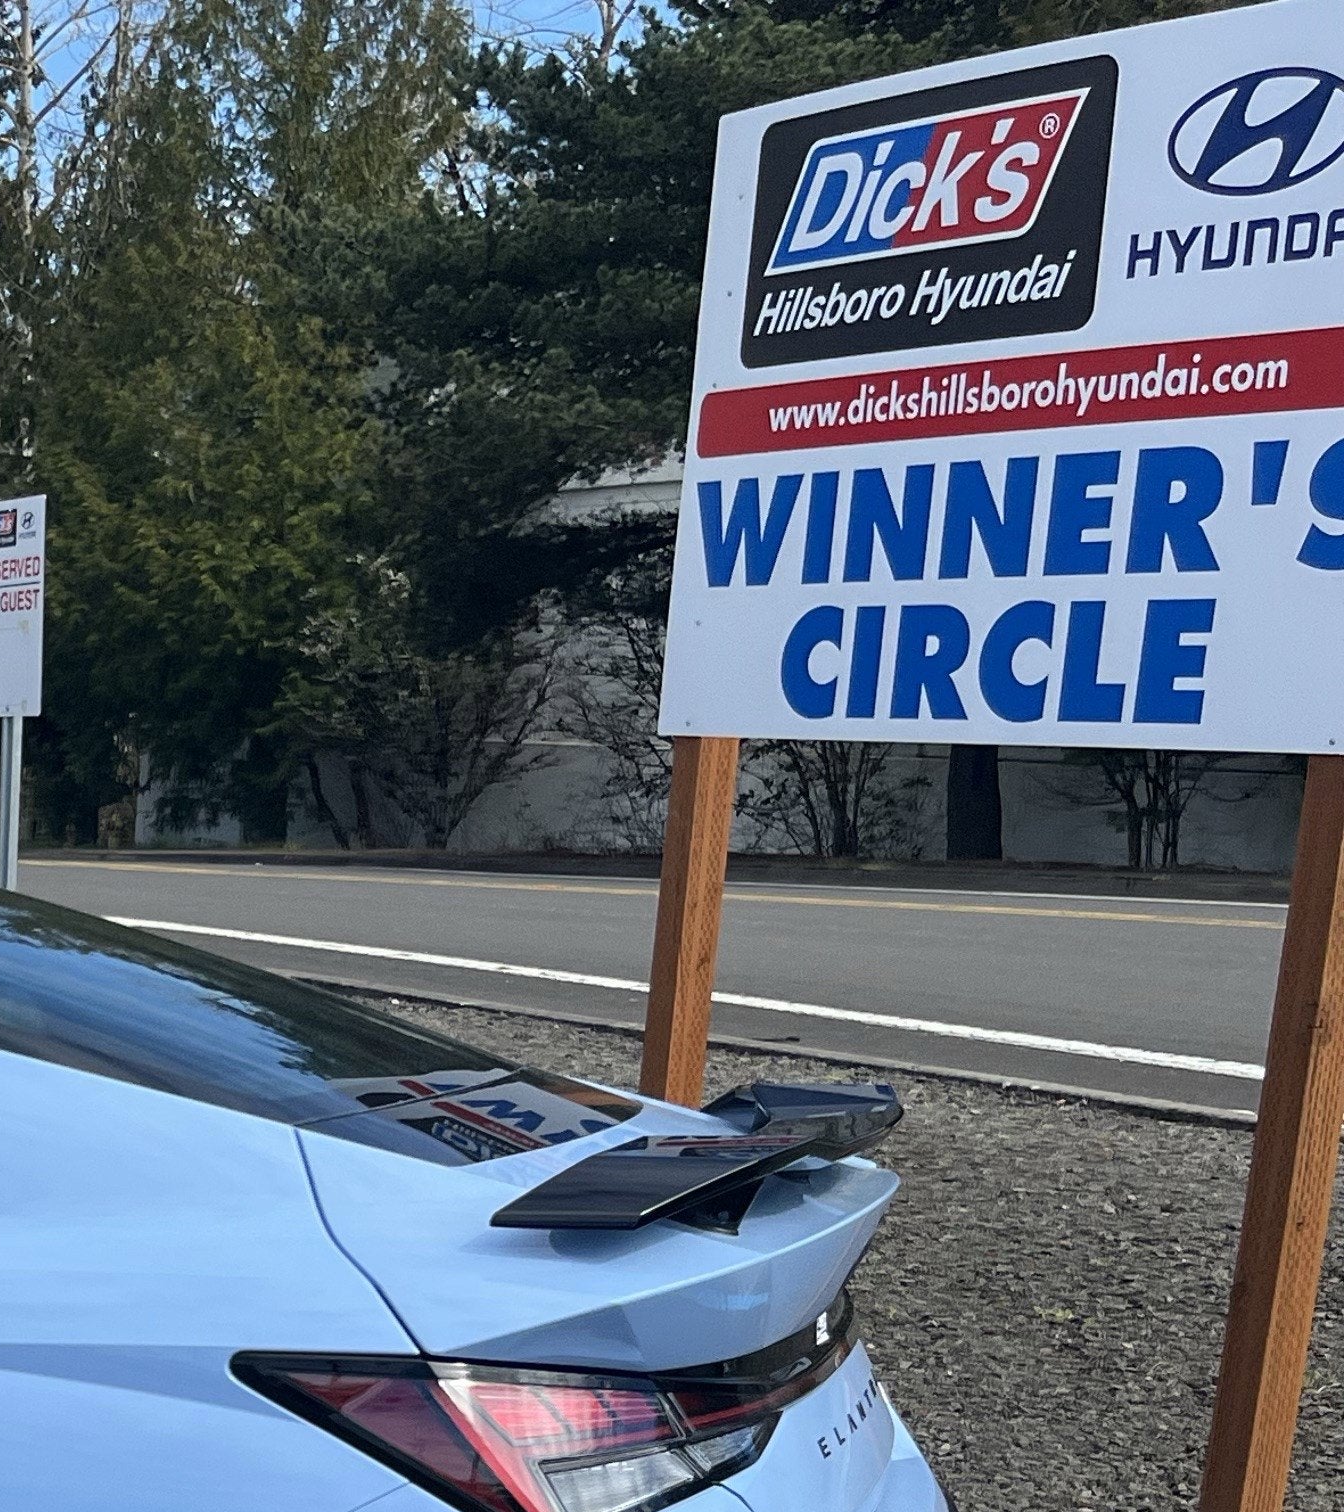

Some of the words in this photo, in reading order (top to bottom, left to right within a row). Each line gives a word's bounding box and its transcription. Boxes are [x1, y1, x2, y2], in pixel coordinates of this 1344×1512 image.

[788, 118, 1040, 253] Dick's
[753, 281, 906, 337] Hillsboro
[909, 249, 1077, 325] Hyundai
[768, 353, 1289, 432] www.dickshillsborohyundai.com
[0, 589, 40, 612] GUEST
[780, 598, 1217, 724] CIRCLE
